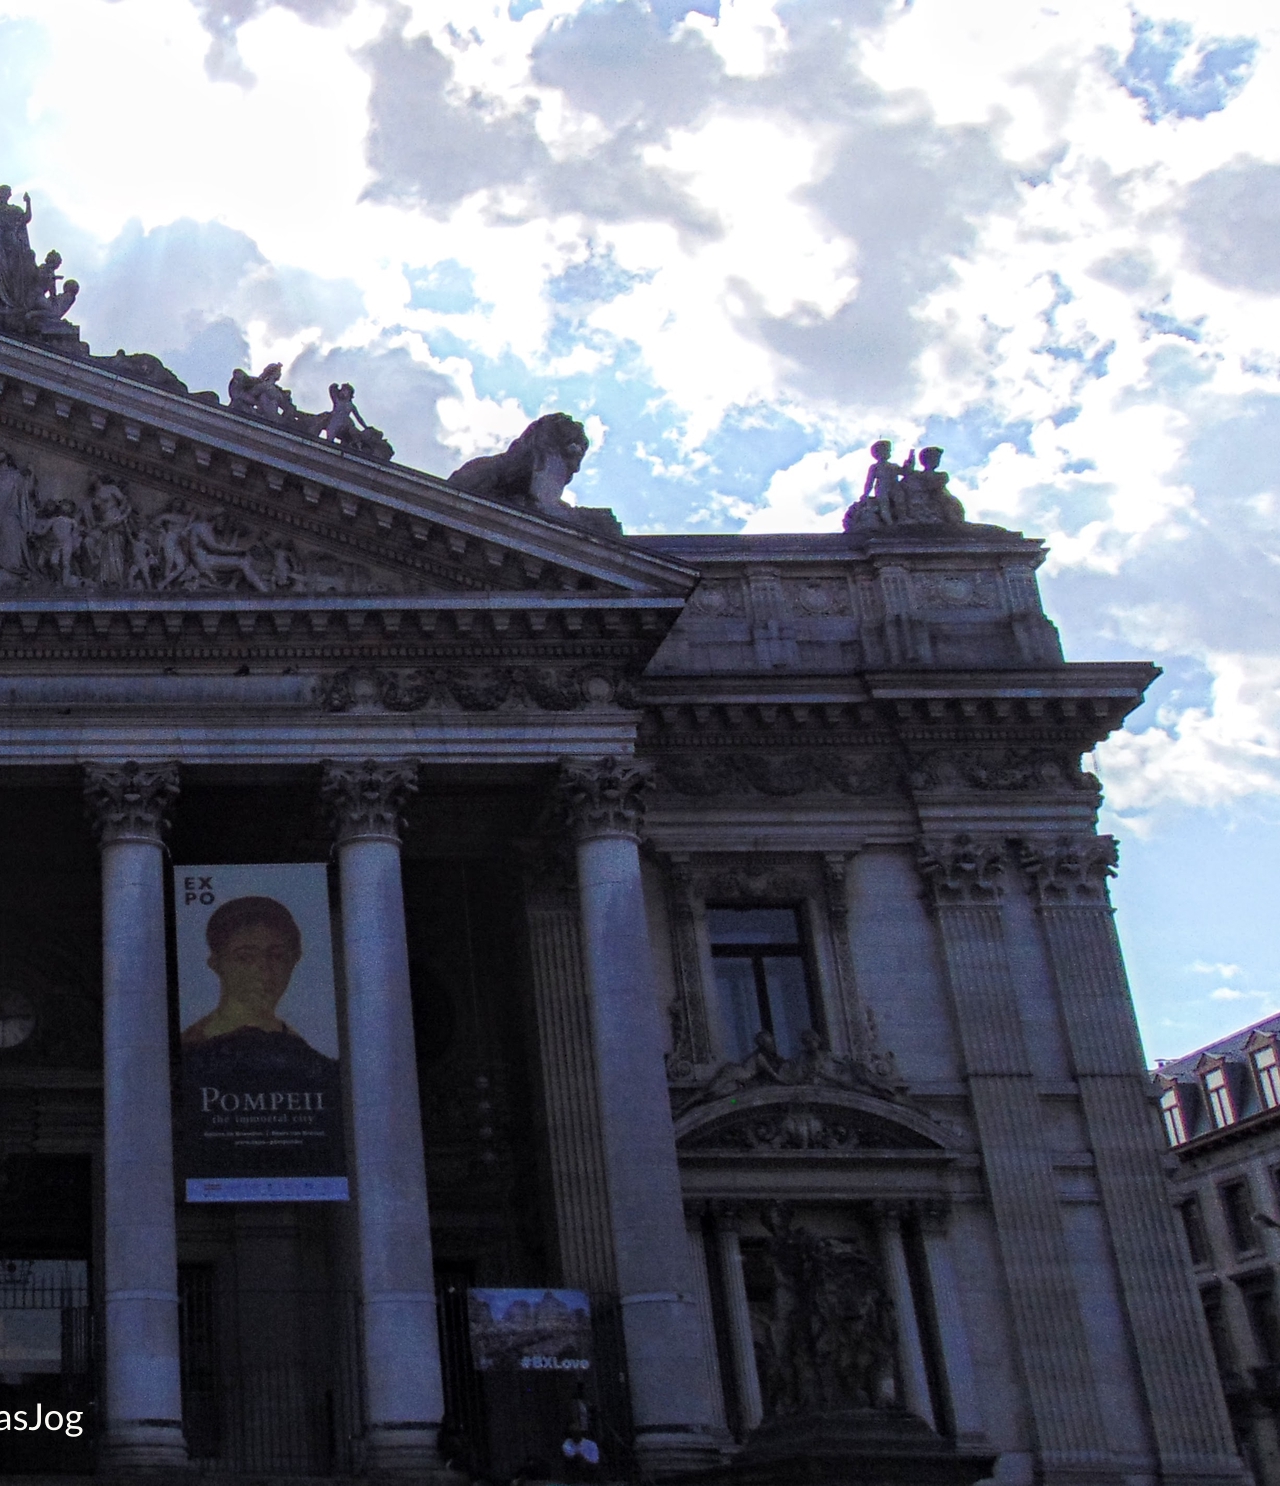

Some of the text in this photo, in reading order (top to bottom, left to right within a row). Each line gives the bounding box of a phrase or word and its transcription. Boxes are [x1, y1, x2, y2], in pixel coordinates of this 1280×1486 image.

[185, 876, 213, 890] EX
[185, 891, 215, 905] PO
[199, 1087, 325, 1112] POMPEII
[212, 1114, 315, 1124] the immortal city
